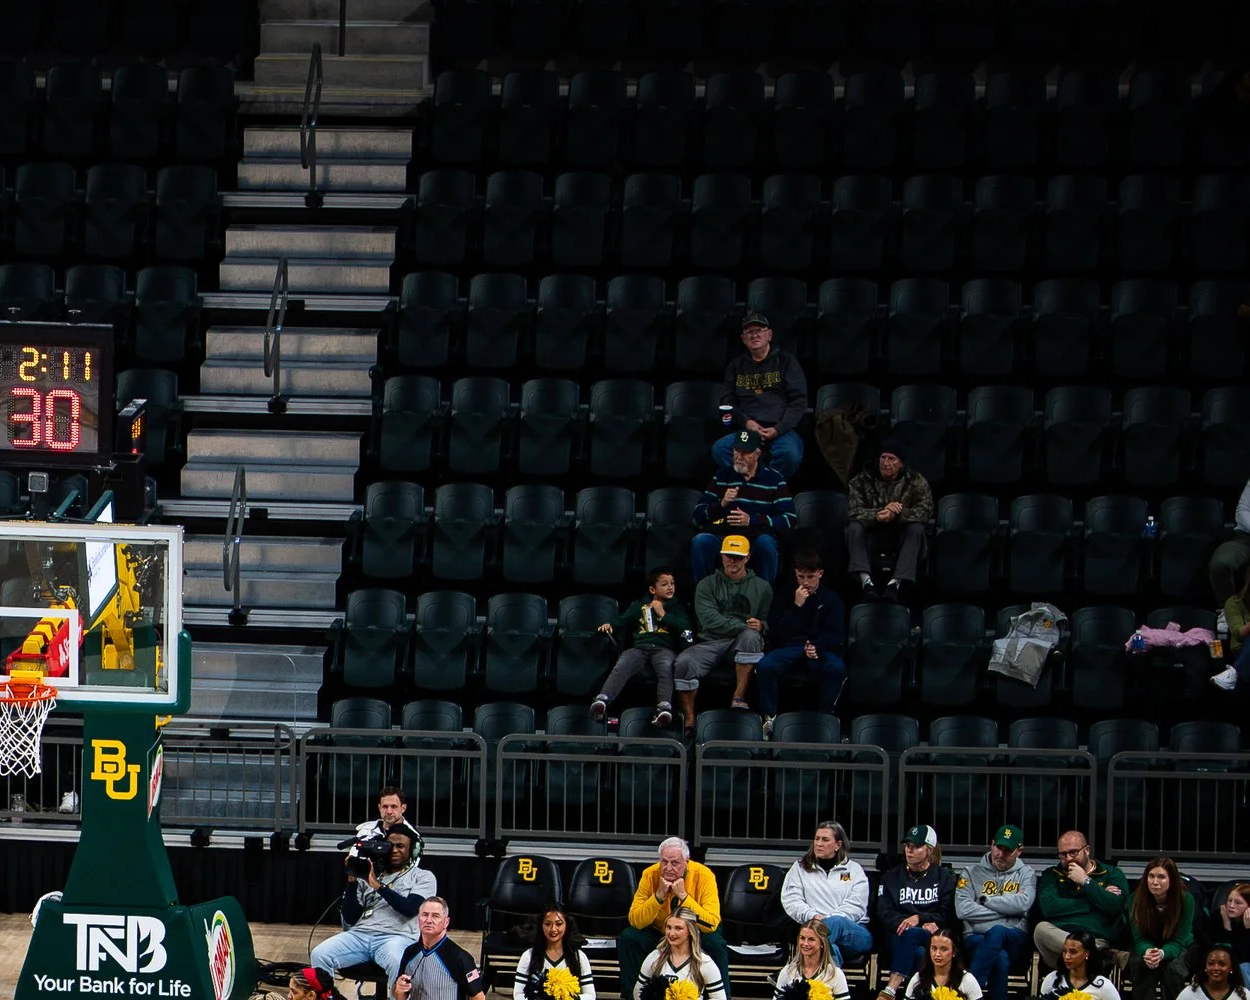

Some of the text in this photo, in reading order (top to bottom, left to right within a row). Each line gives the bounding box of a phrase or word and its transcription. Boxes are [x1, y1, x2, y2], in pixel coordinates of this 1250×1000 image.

[19, 347, 91, 381] 2:11
[12, 388, 81, 450] 30
[91, 739, 141, 800] BU
[518, 859, 538, 881] BU
[593, 861, 614, 884] BU
[748, 867, 769, 890] BU
[899, 887, 939, 902] BAYLOR
[63, 913, 168, 973] TNB
[33, 974, 192, 998] Your Bank for Life
